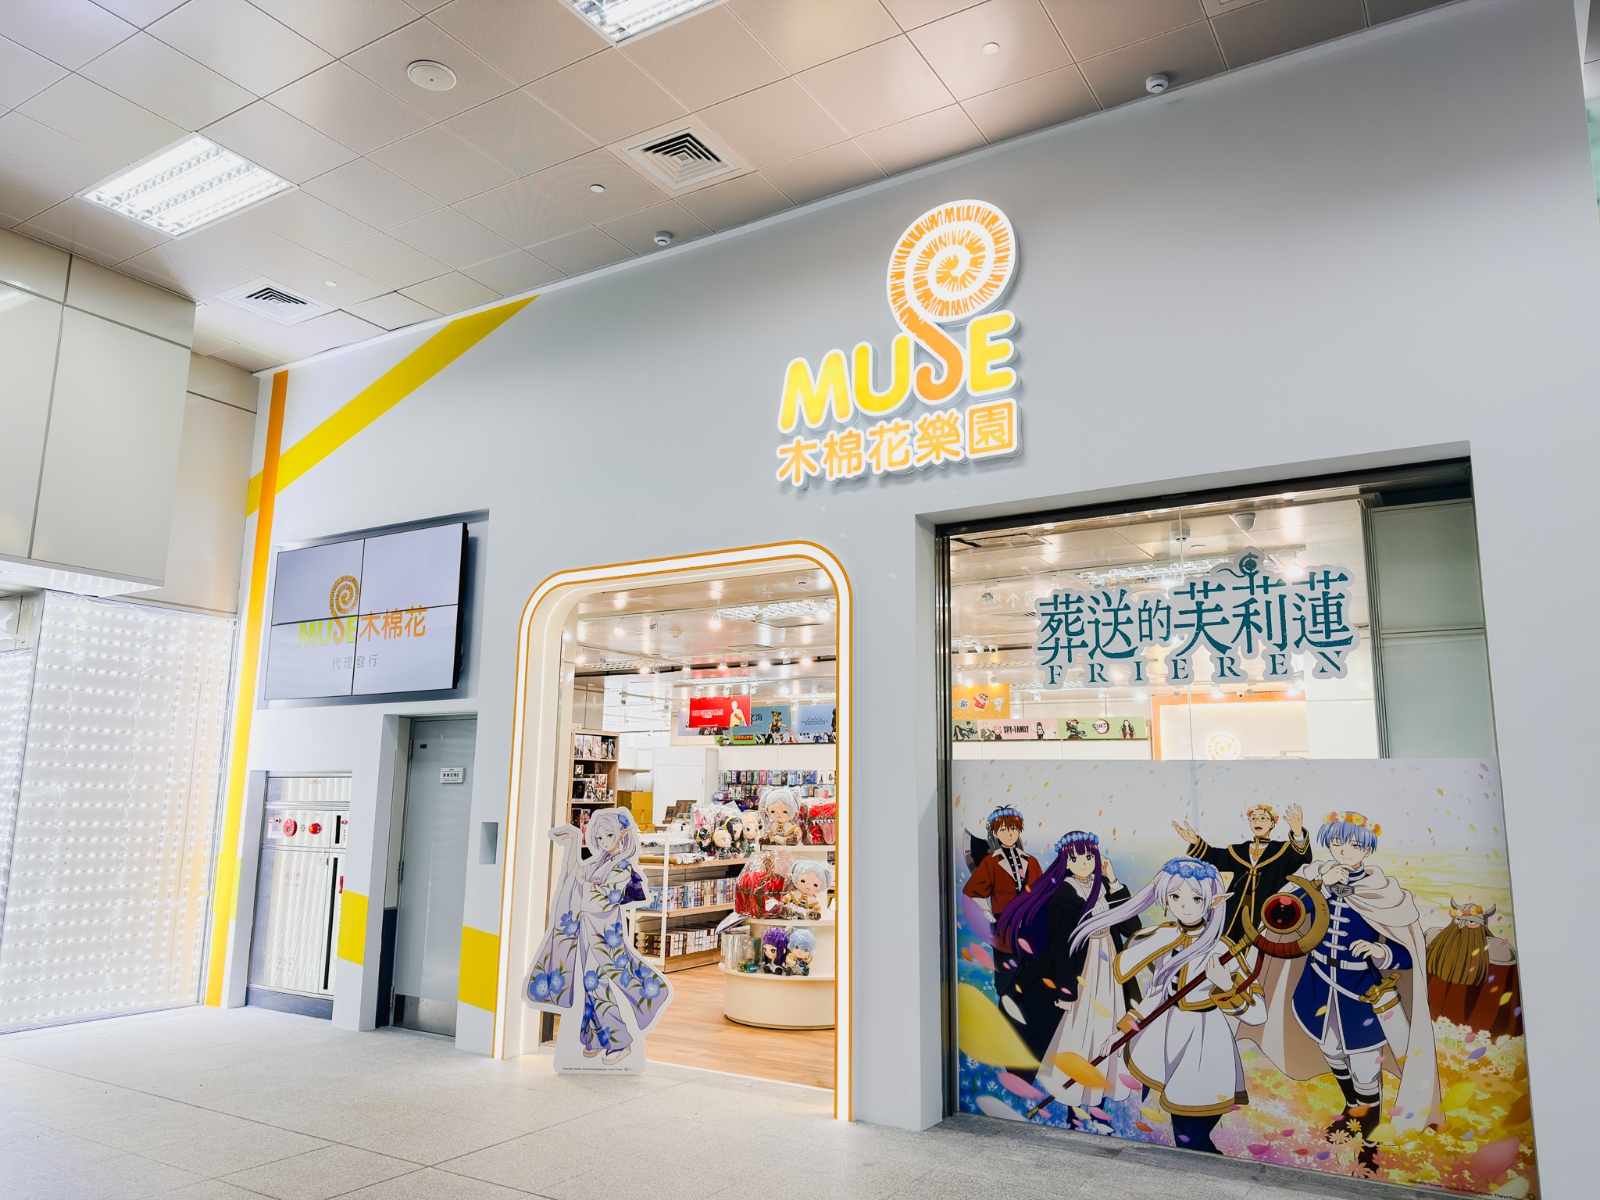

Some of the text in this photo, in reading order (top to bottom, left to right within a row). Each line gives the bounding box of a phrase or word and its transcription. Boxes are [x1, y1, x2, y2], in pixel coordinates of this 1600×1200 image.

[779, 201, 1016, 433] MUSE
[777, 401, 1015, 485] 木棉花樂園
[296, 575, 428, 648] MUSE 木棉花
[1038, 553, 1354, 667] 葬送的芙莉蓮
[332, 654, 378, 671] 代理發行
[1047, 650, 1344, 685] FRIEREN
